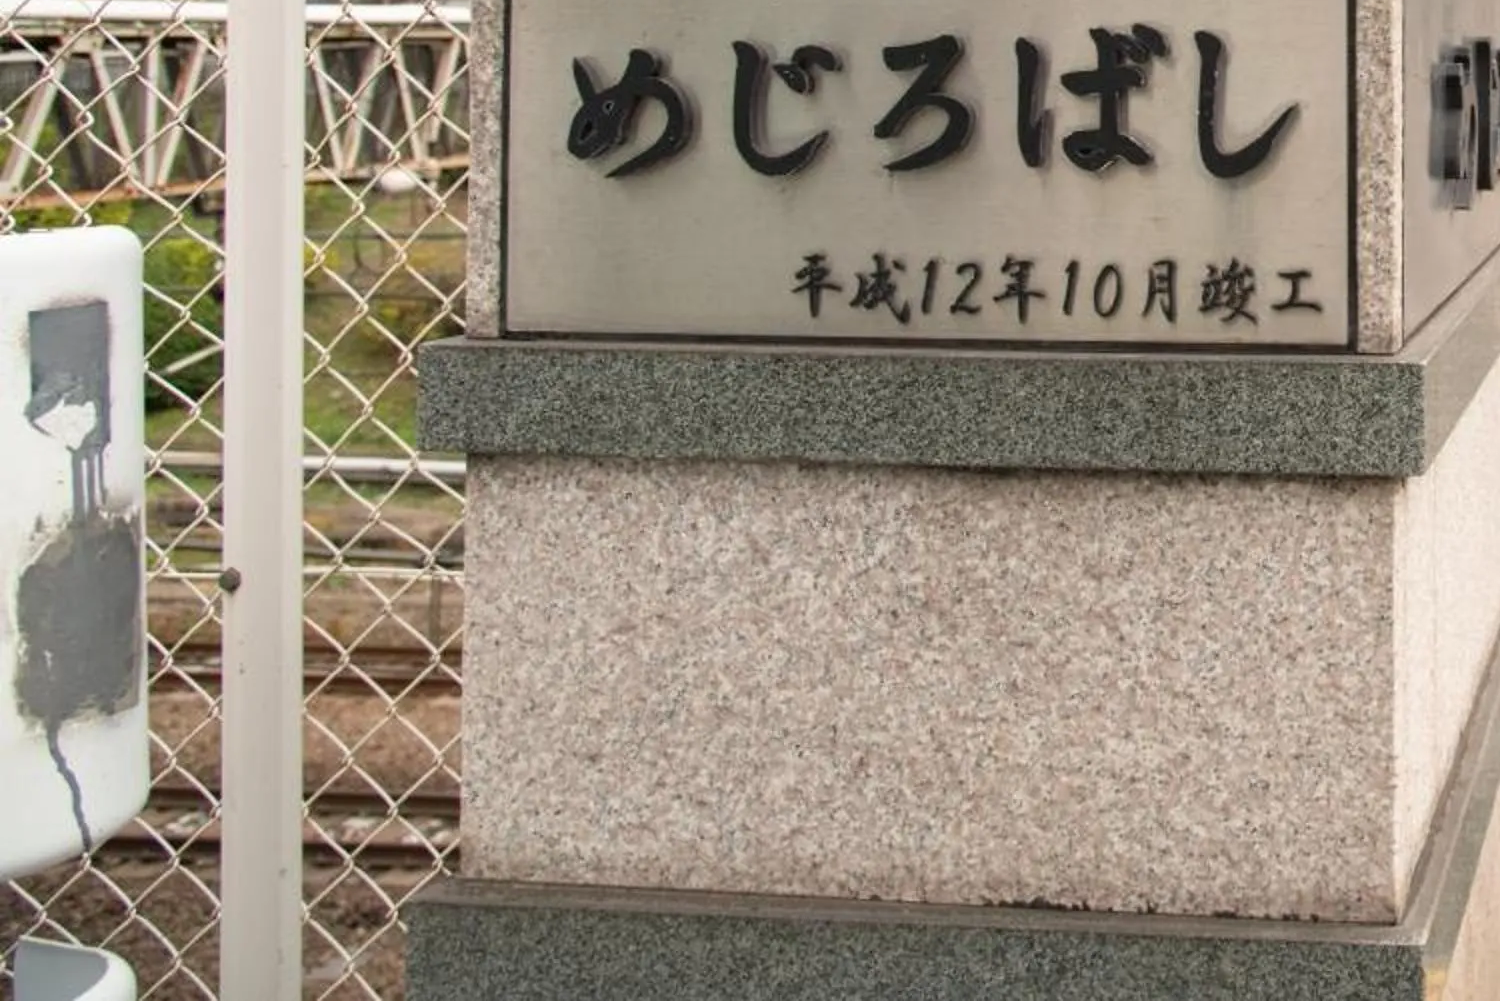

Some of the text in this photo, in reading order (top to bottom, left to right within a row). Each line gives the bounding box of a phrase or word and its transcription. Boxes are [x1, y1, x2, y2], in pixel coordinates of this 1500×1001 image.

[566, 23, 1300, 179] めじろばし
[793, 253, 1323, 326] 平成12年10月竣工
